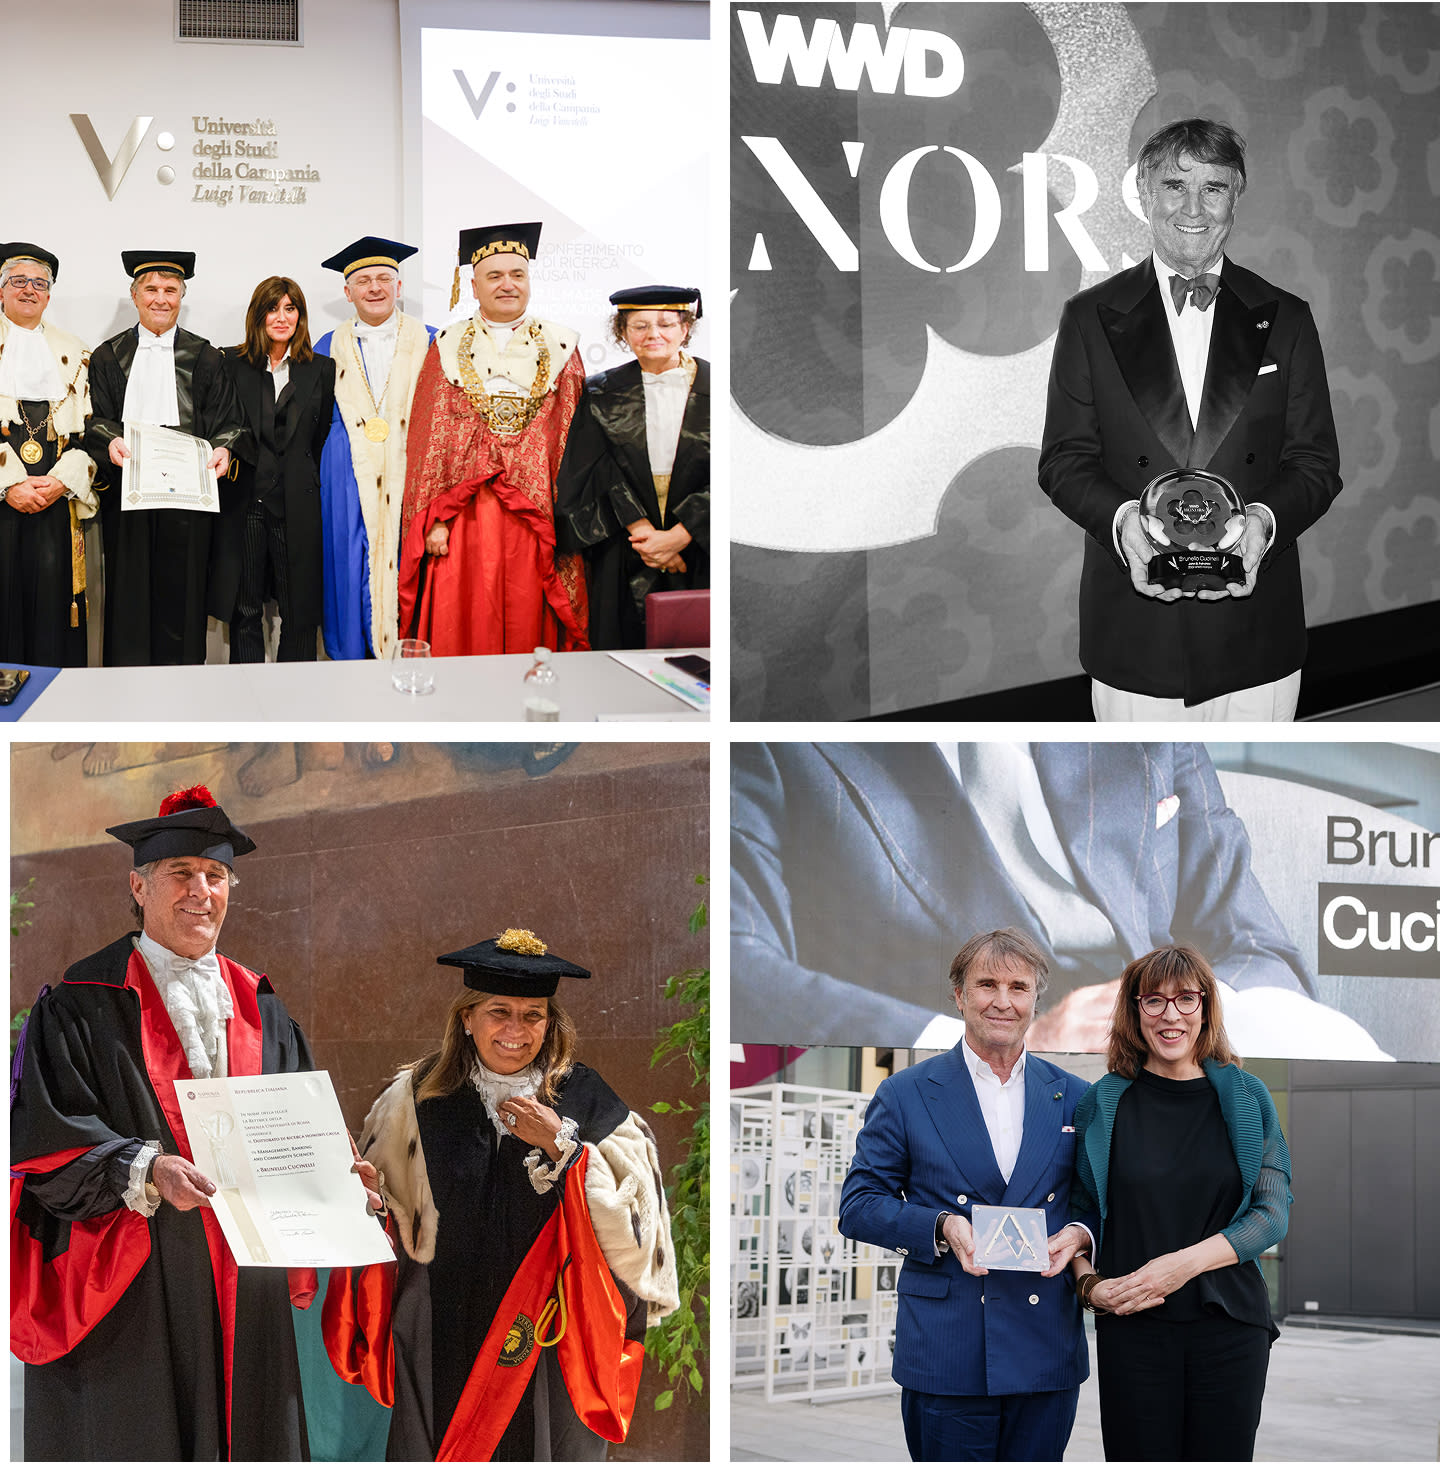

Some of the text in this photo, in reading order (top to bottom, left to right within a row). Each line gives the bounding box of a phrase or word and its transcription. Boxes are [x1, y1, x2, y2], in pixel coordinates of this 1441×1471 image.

[737, 10, 965, 98] WWD
[192, 116, 277, 135] Università
[193, 139, 278, 160] degli Studi
[193, 162, 320, 185] della Campania
[192, 185, 233, 207] Luigi
[740, 135, 1153, 274] NOR
[533, 270, 569, 282] AUSA
